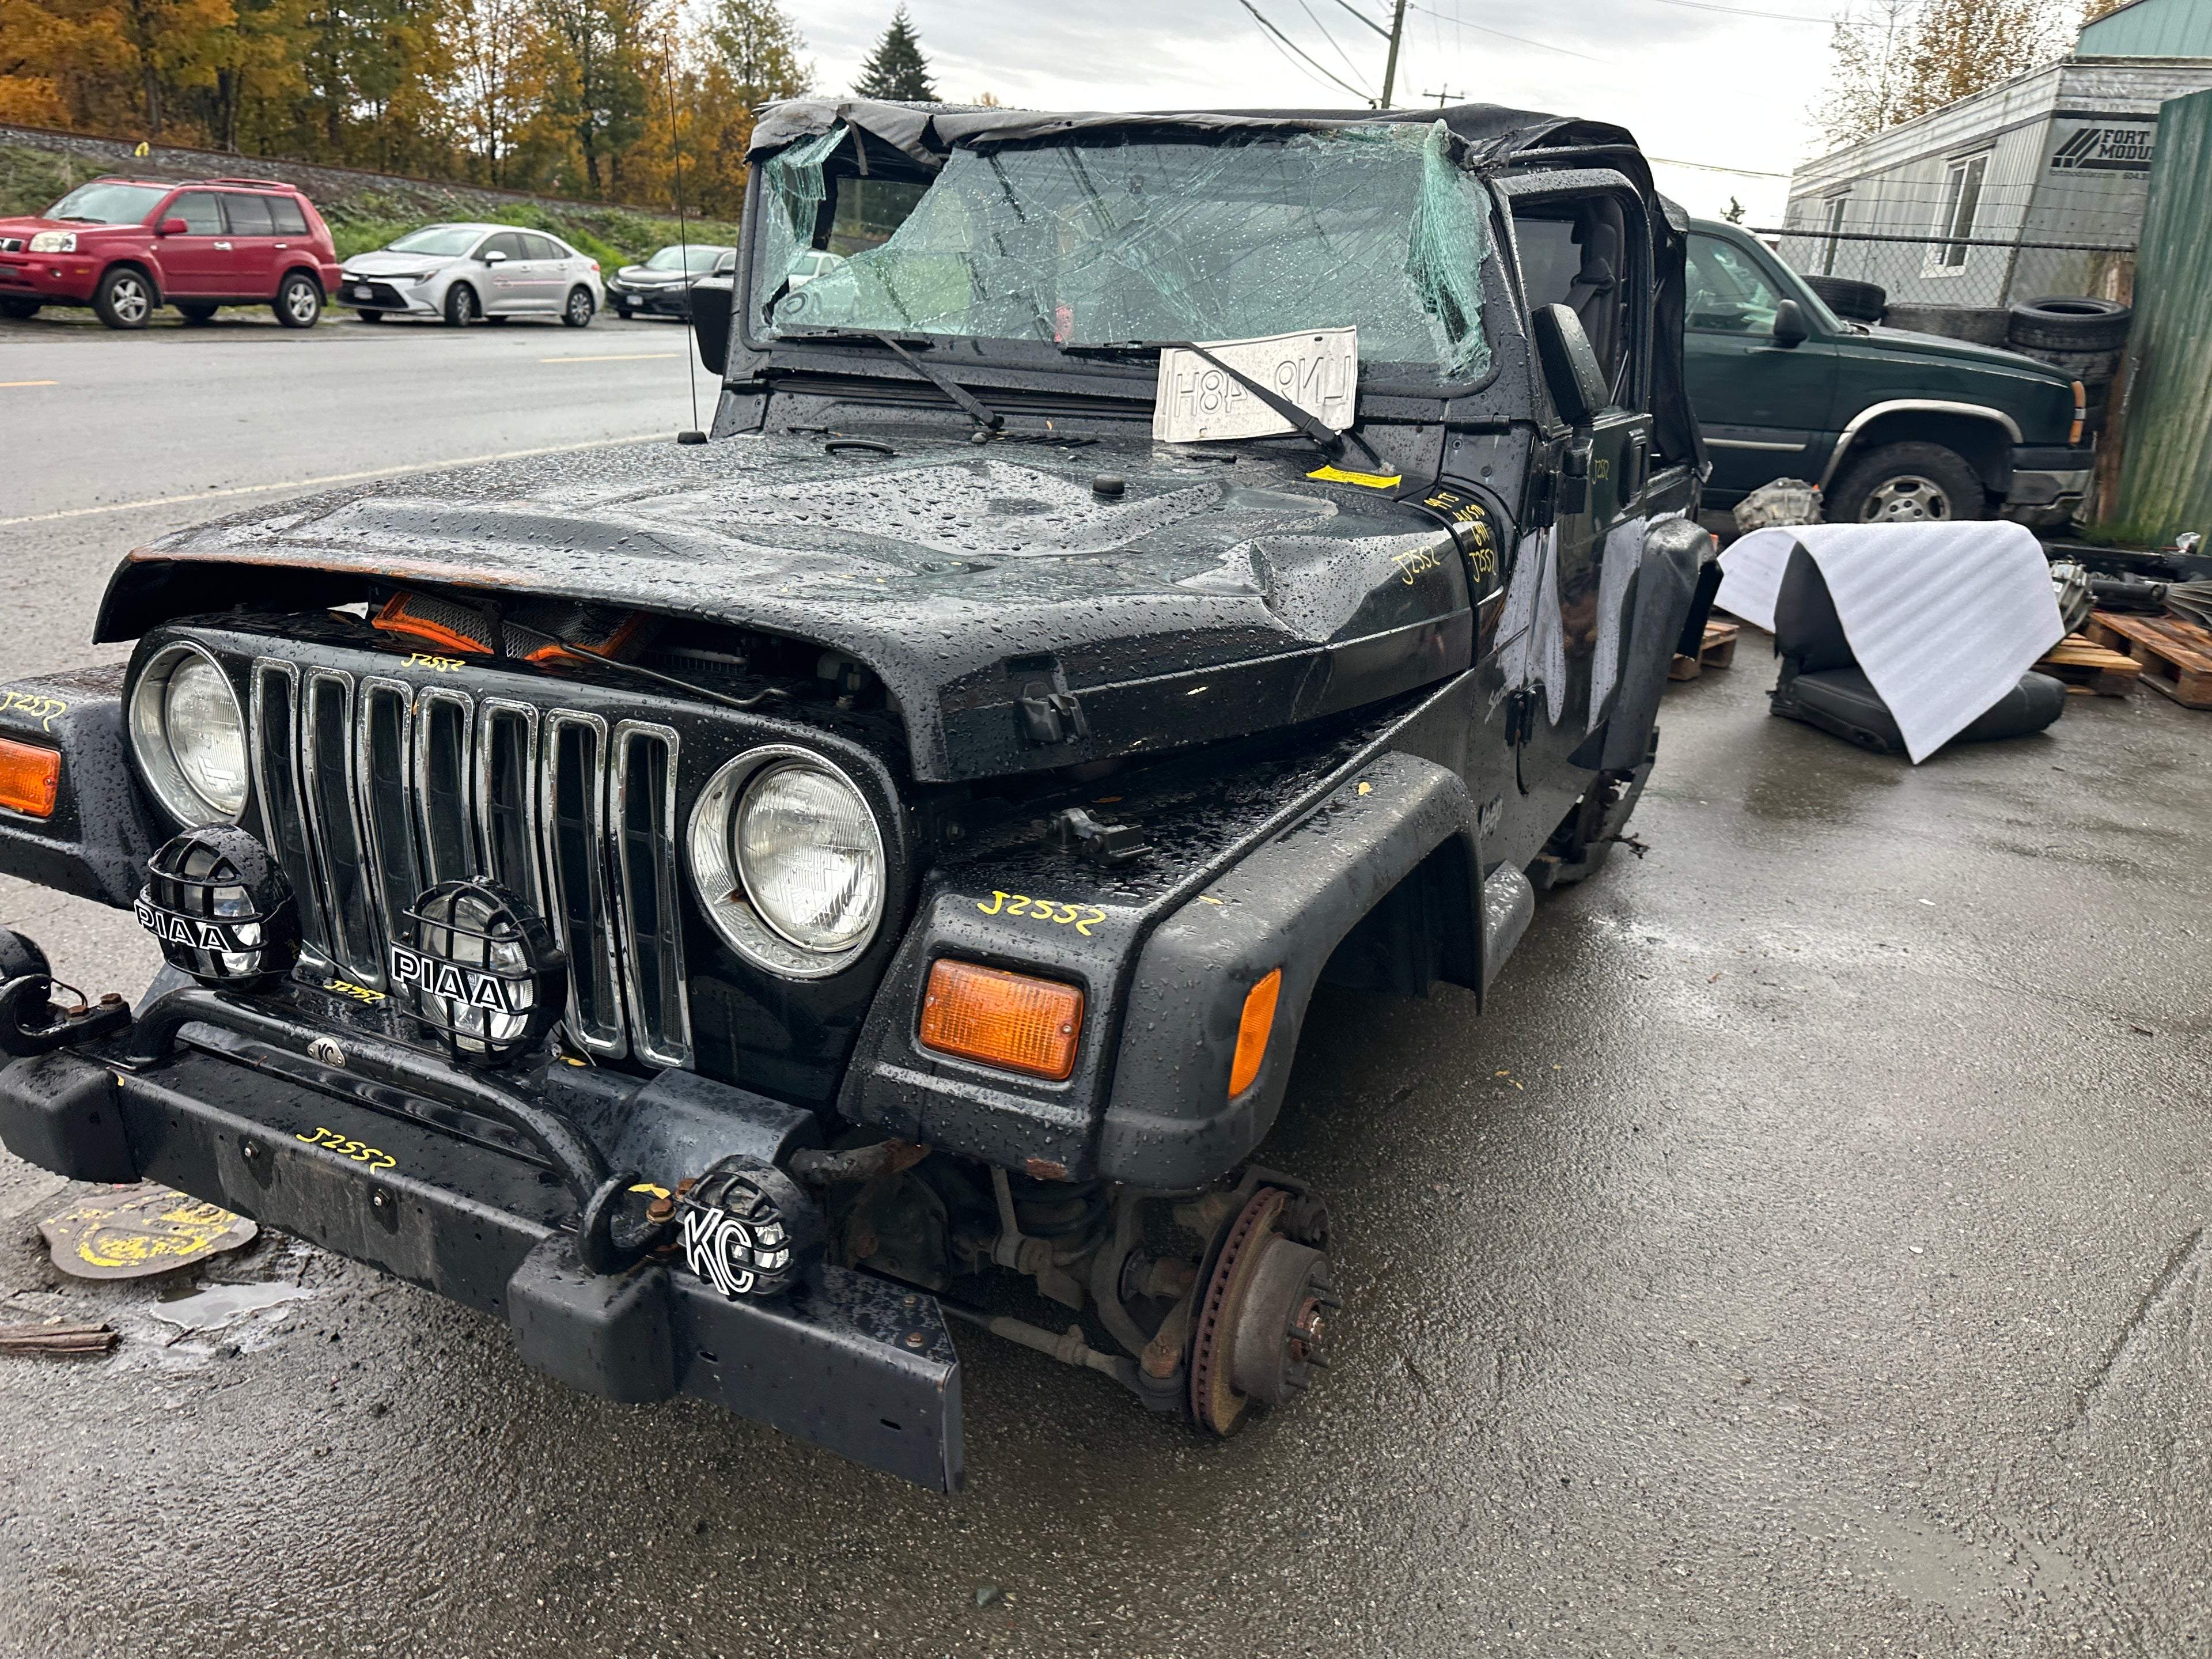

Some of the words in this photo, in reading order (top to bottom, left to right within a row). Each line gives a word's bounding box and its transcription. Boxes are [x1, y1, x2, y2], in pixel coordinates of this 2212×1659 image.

[2098, 144, 2154, 160] MODU
[2101, 129, 2150, 145] FORT
[1391, 546, 1440, 585] J2552
[1469, 548, 1497, 582] J2552
[401, 653, 465, 672] J2552
[134, 899, 233, 953] PIAA
[976, 891, 1106, 936] J2552
[392, 946, 509, 1014] PIAA
[296, 1127, 396, 1175] J2552
[684, 1207, 754, 1296] KC
